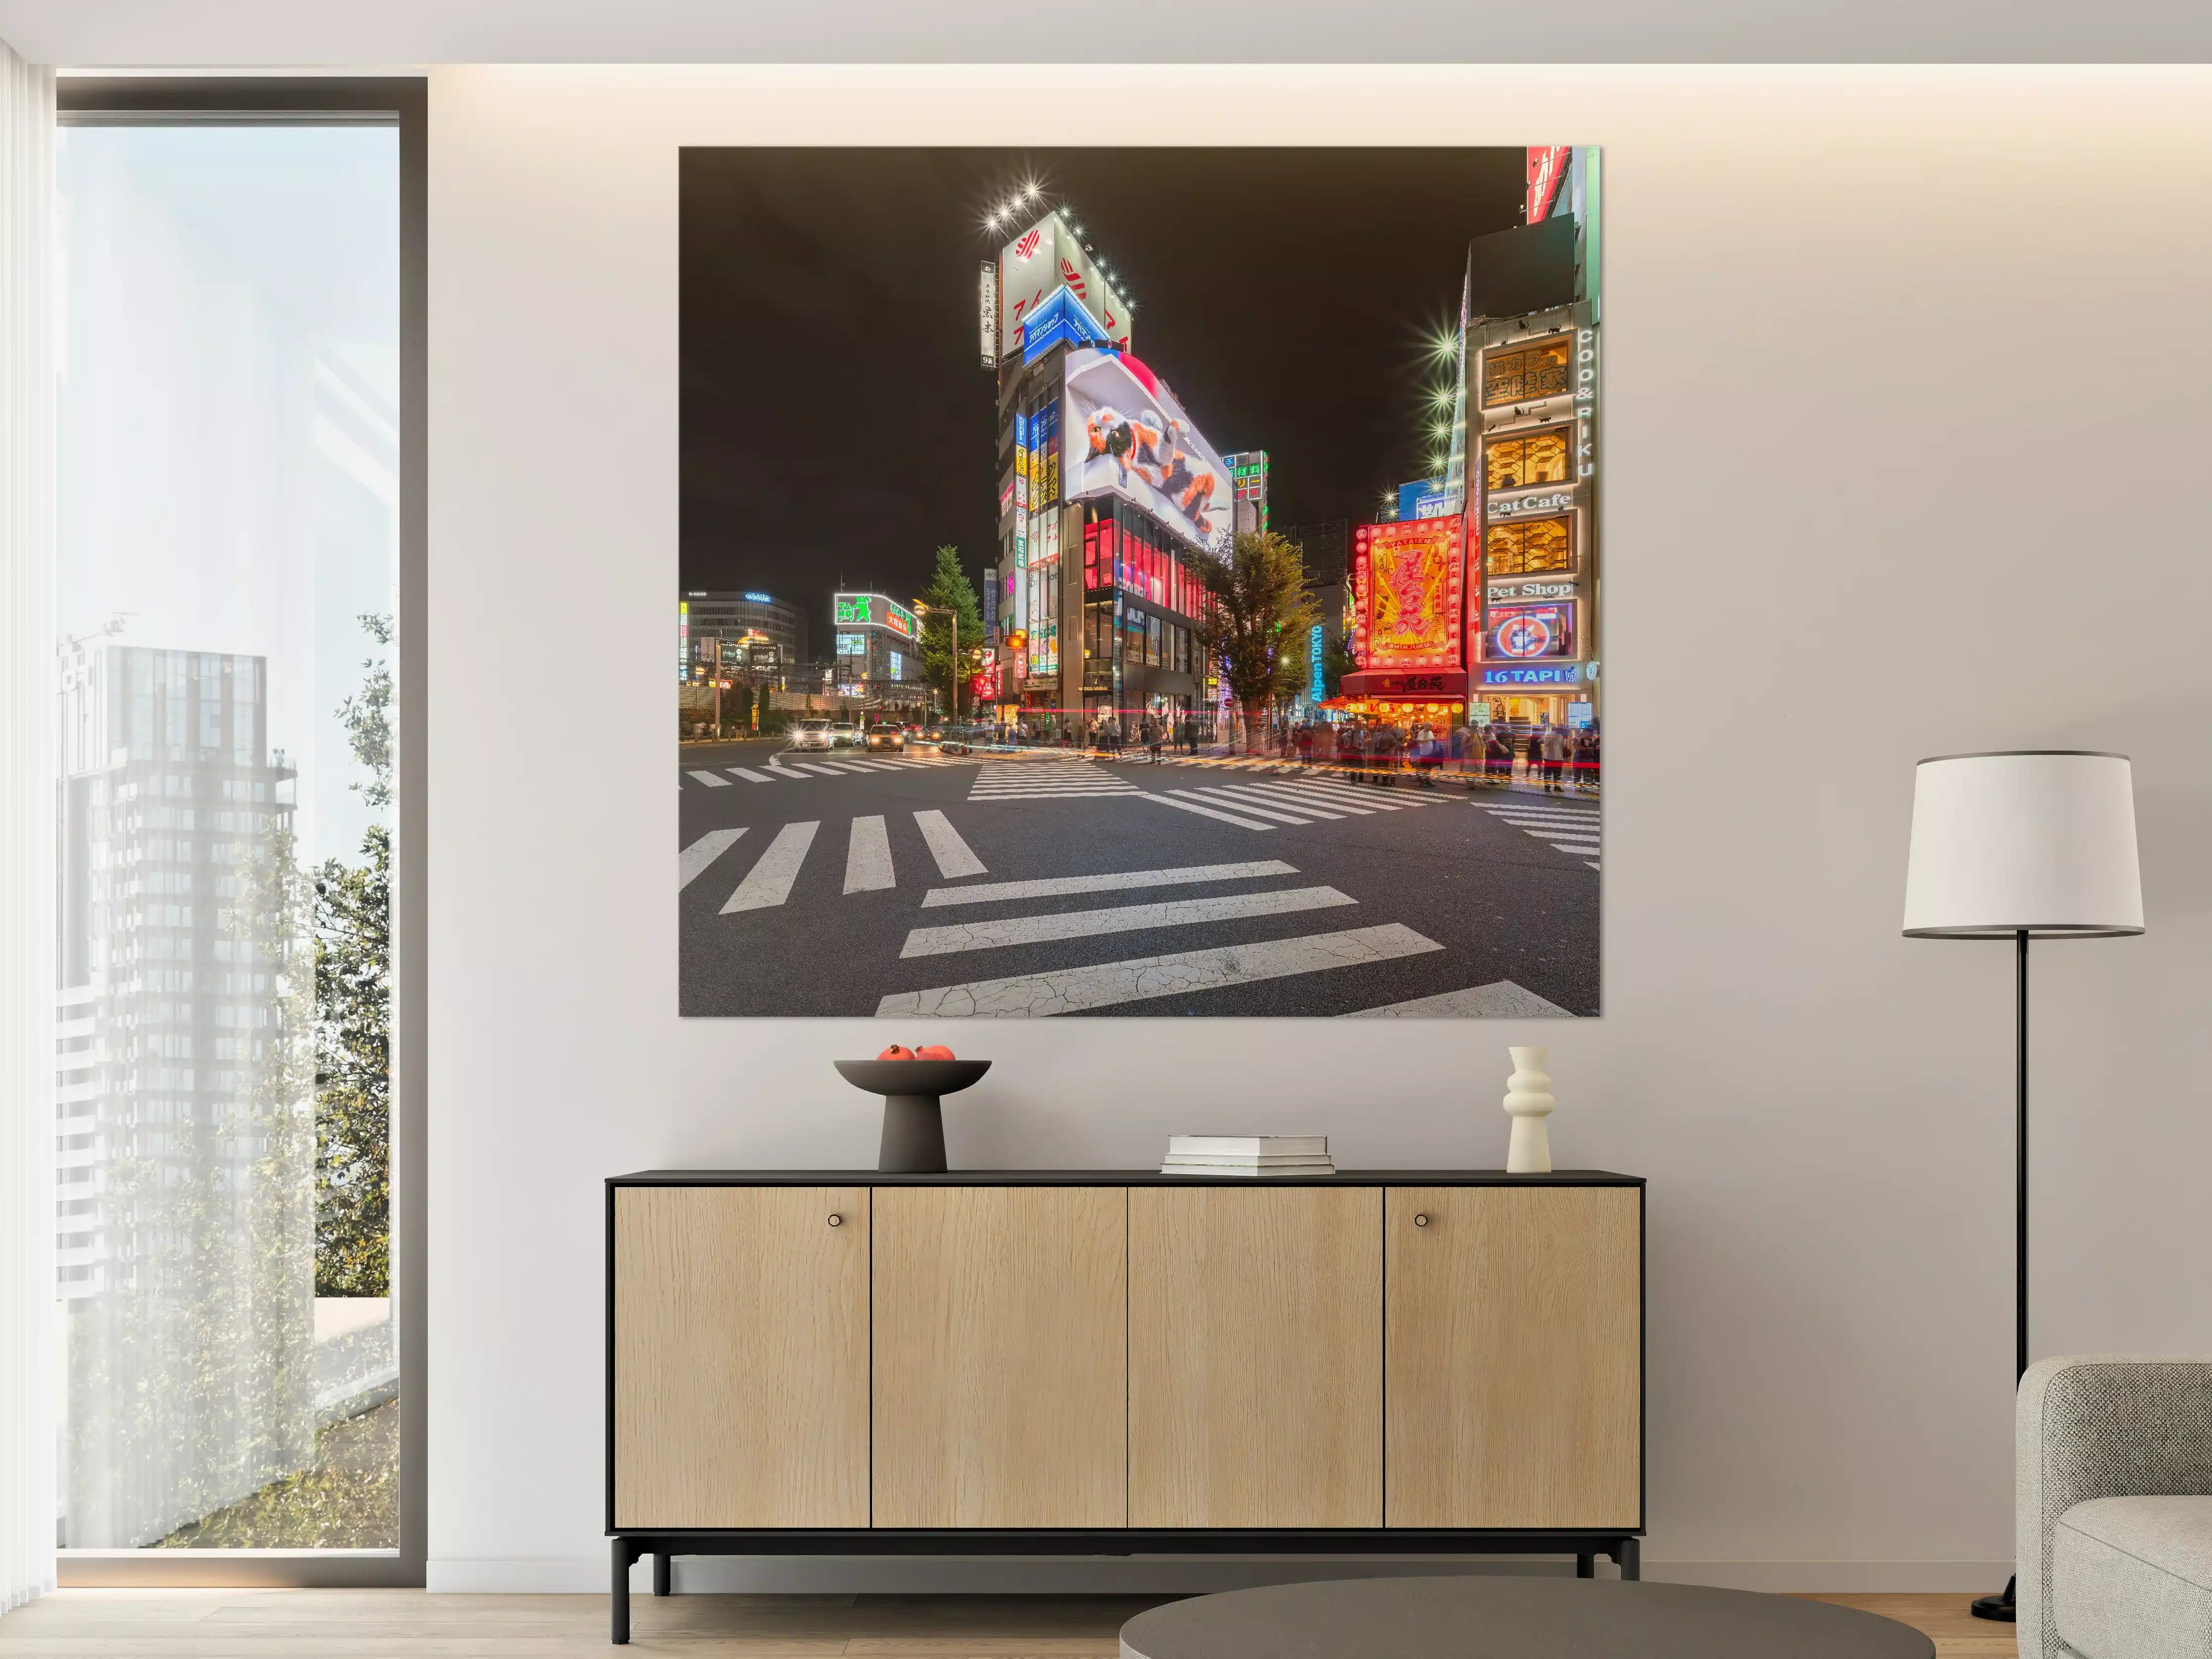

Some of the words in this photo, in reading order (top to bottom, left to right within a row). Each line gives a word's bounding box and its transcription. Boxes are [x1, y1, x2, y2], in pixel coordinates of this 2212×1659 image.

[1487, 497, 1523, 513] Cat
[1523, 494, 1571, 508] Cafe
[1391, 538, 1431, 548] YATAIEN
[1488, 586, 1516, 598] Pet
[1522, 583, 1571, 598] Shop
[1311, 625, 1322, 662] TOKYO
[1311, 663, 1325, 702] Alpen
[1484, 671, 1508, 683] 16
[1511, 670, 1560, 682] TAPI
